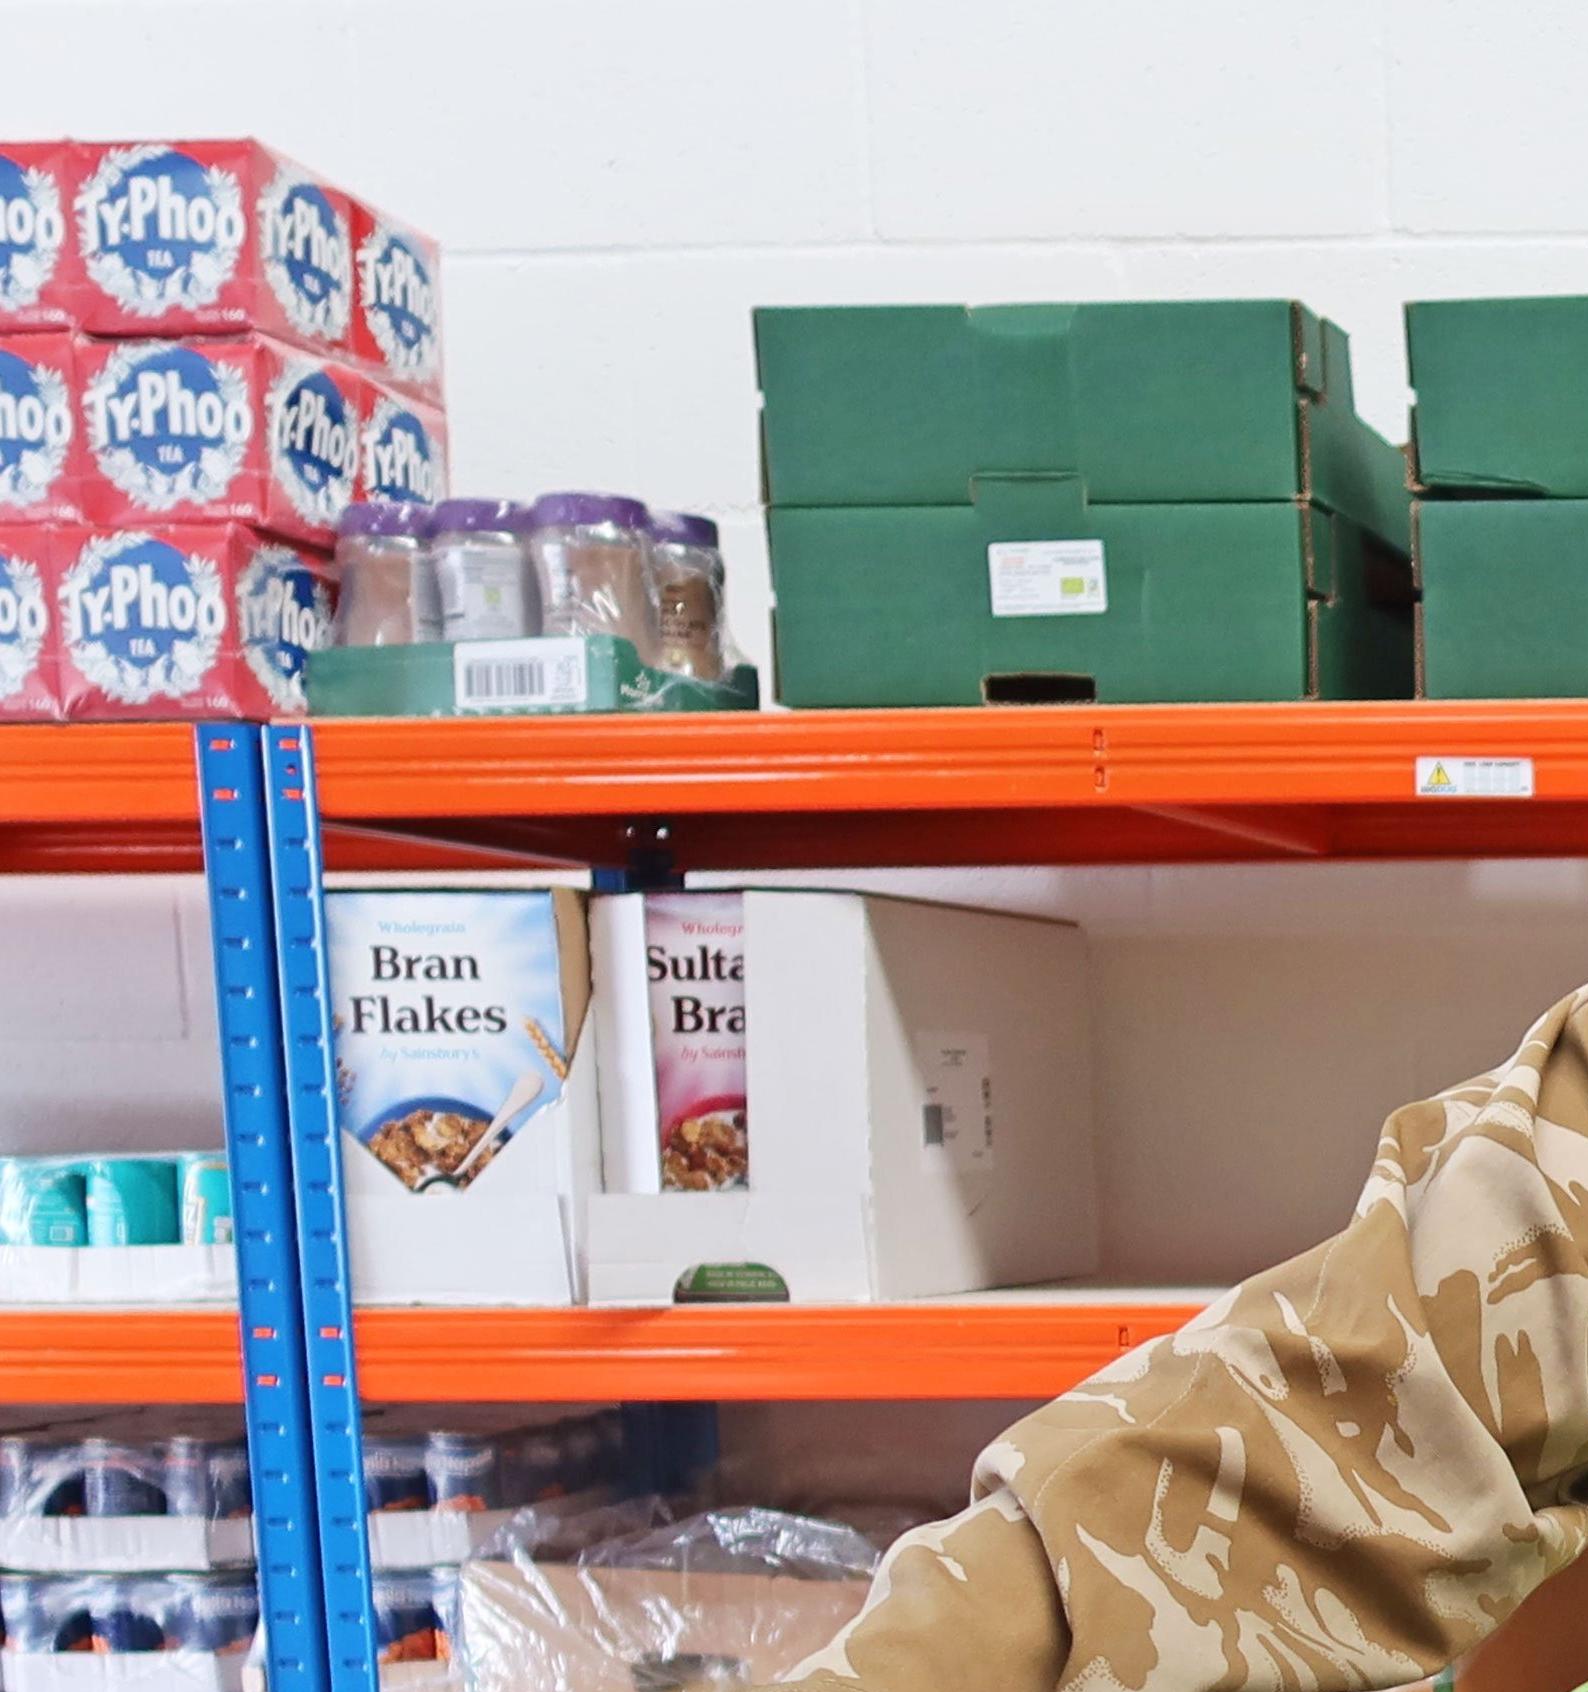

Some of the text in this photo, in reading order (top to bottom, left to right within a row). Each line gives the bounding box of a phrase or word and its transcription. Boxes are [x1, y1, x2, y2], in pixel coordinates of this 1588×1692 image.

[370, 945, 481, 981] Bran
[350, 995, 508, 1034] Flakes
[671, 995, 746, 1034] Bra
